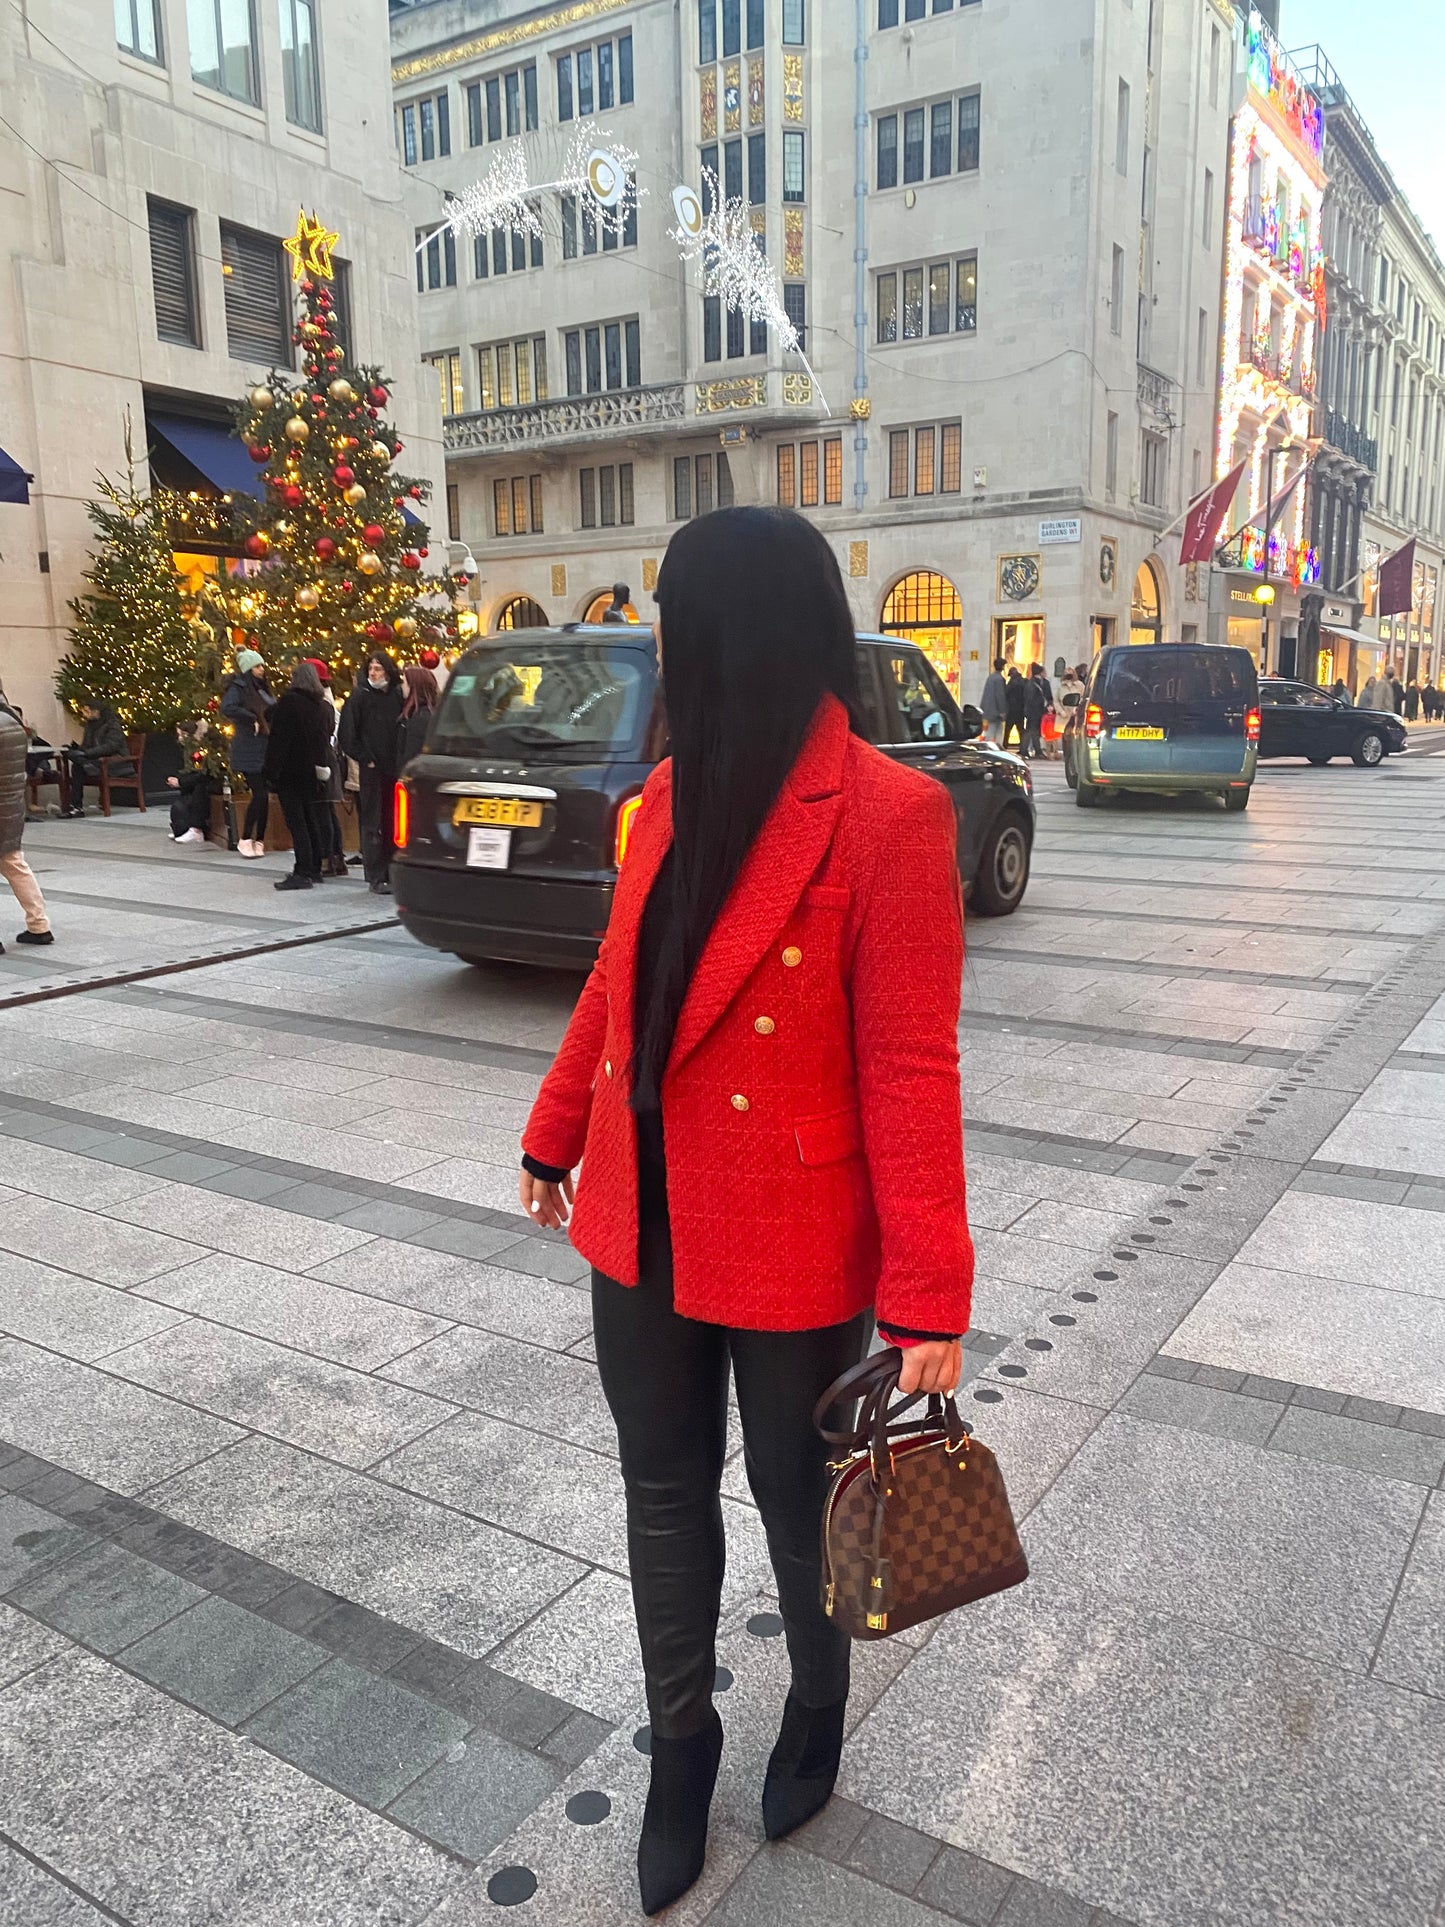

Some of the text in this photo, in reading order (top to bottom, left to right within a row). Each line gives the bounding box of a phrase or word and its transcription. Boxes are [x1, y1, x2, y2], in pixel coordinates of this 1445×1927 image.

[1041, 521, 1077, 530] BURLINGTON
[1041, 528, 1068, 537] GARDENS
[1119, 728, 1160, 738] HT17 DHY
[870, 1575, 883, 1589] M
